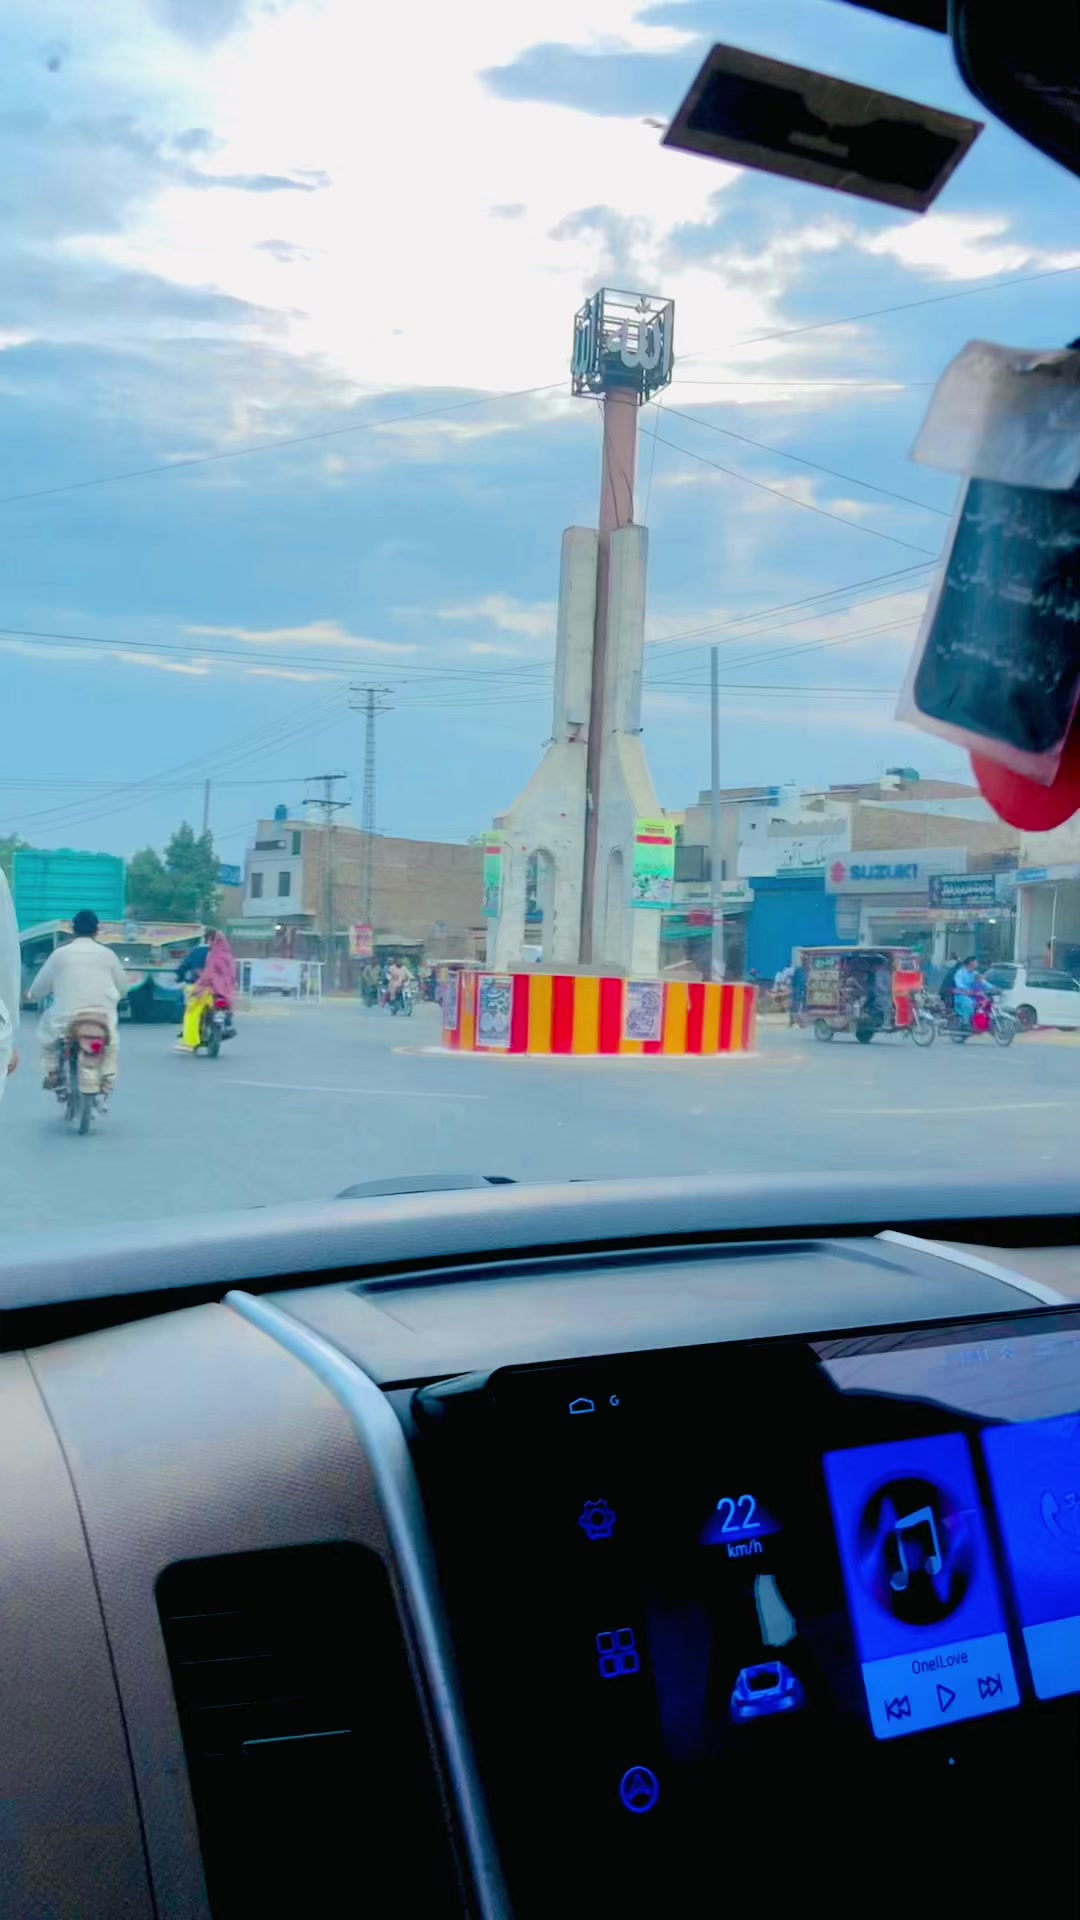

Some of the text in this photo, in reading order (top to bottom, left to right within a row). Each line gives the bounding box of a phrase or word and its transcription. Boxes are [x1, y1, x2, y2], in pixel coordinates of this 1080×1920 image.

[850, 864, 918, 880] SUZUKI
[717, 1494, 760, 1533] 22
[727, 1539, 763, 1558] km/h
